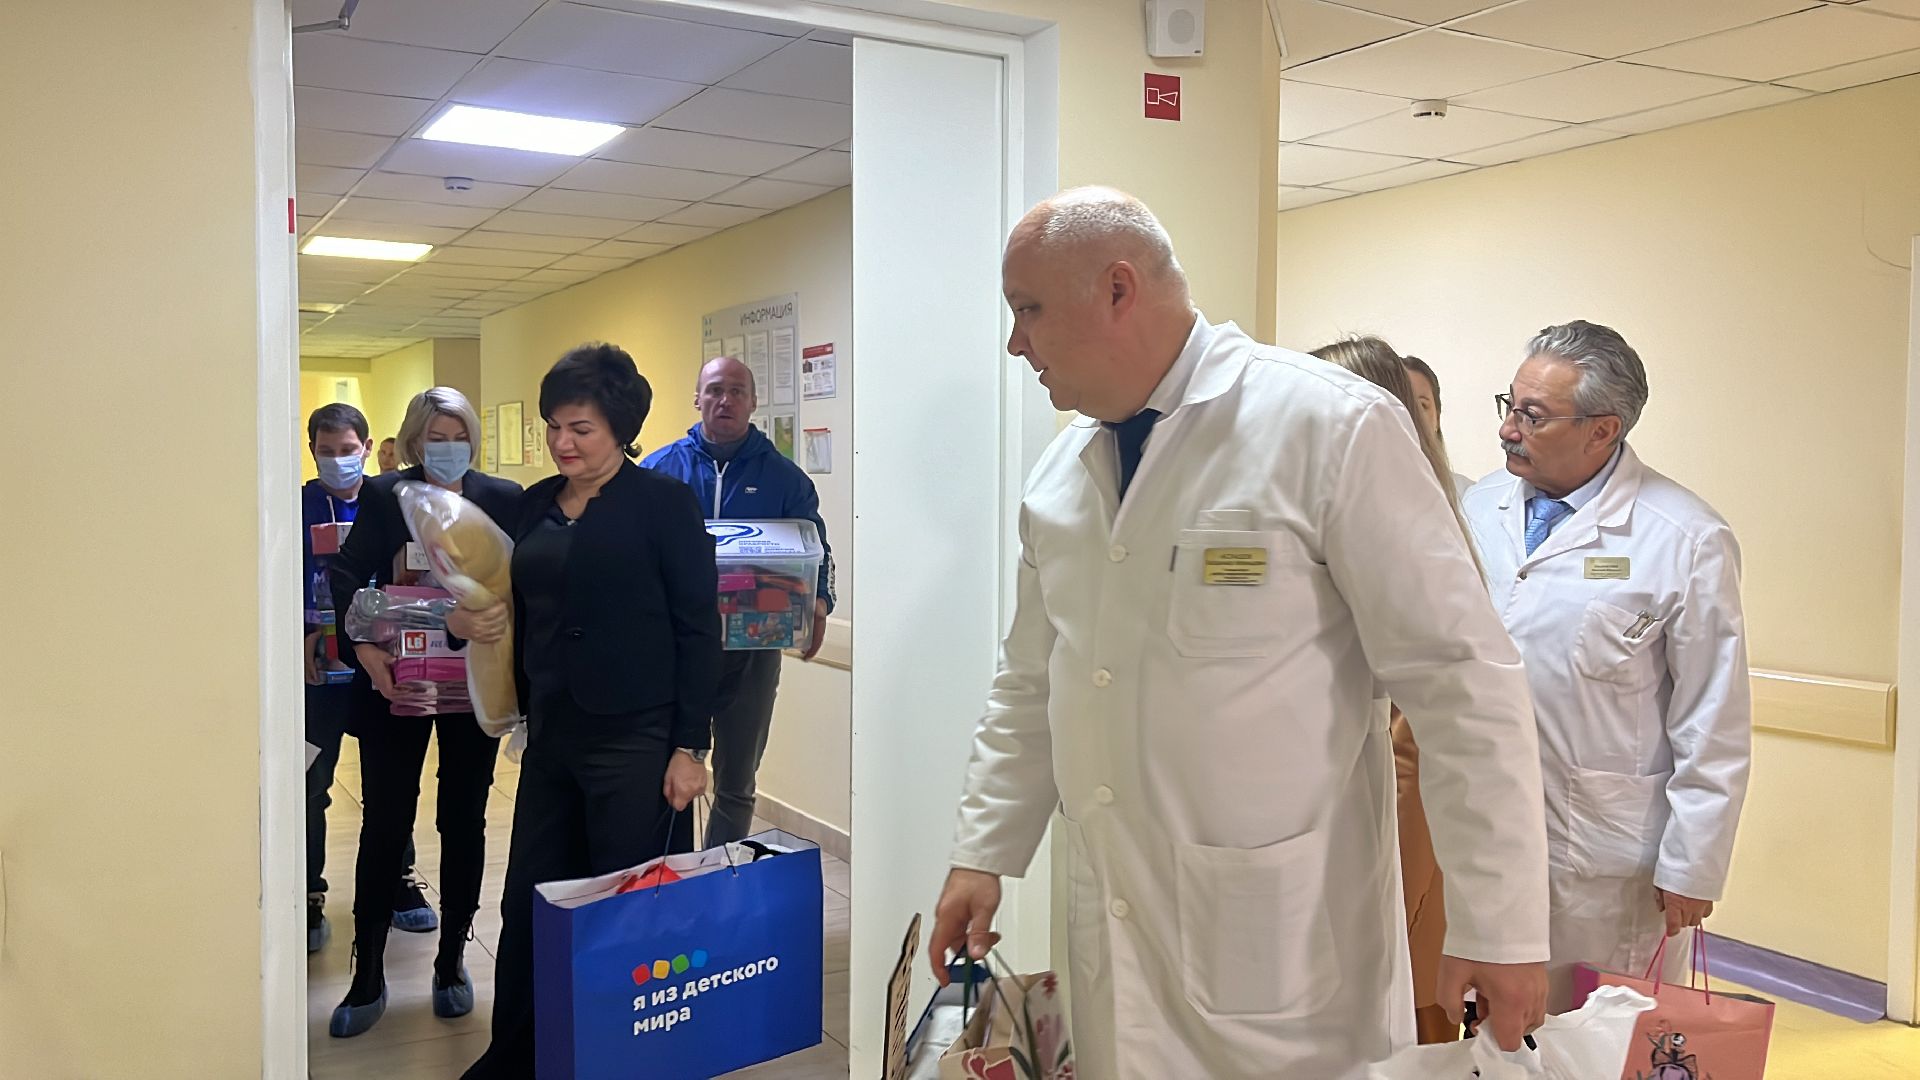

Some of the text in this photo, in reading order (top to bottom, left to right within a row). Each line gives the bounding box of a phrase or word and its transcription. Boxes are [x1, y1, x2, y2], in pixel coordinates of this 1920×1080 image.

[740, 302, 793, 326] ИНФОРМАЦИЯ
[633, 956, 779, 1011] я из детского
[633, 1006, 691, 1036] мира
